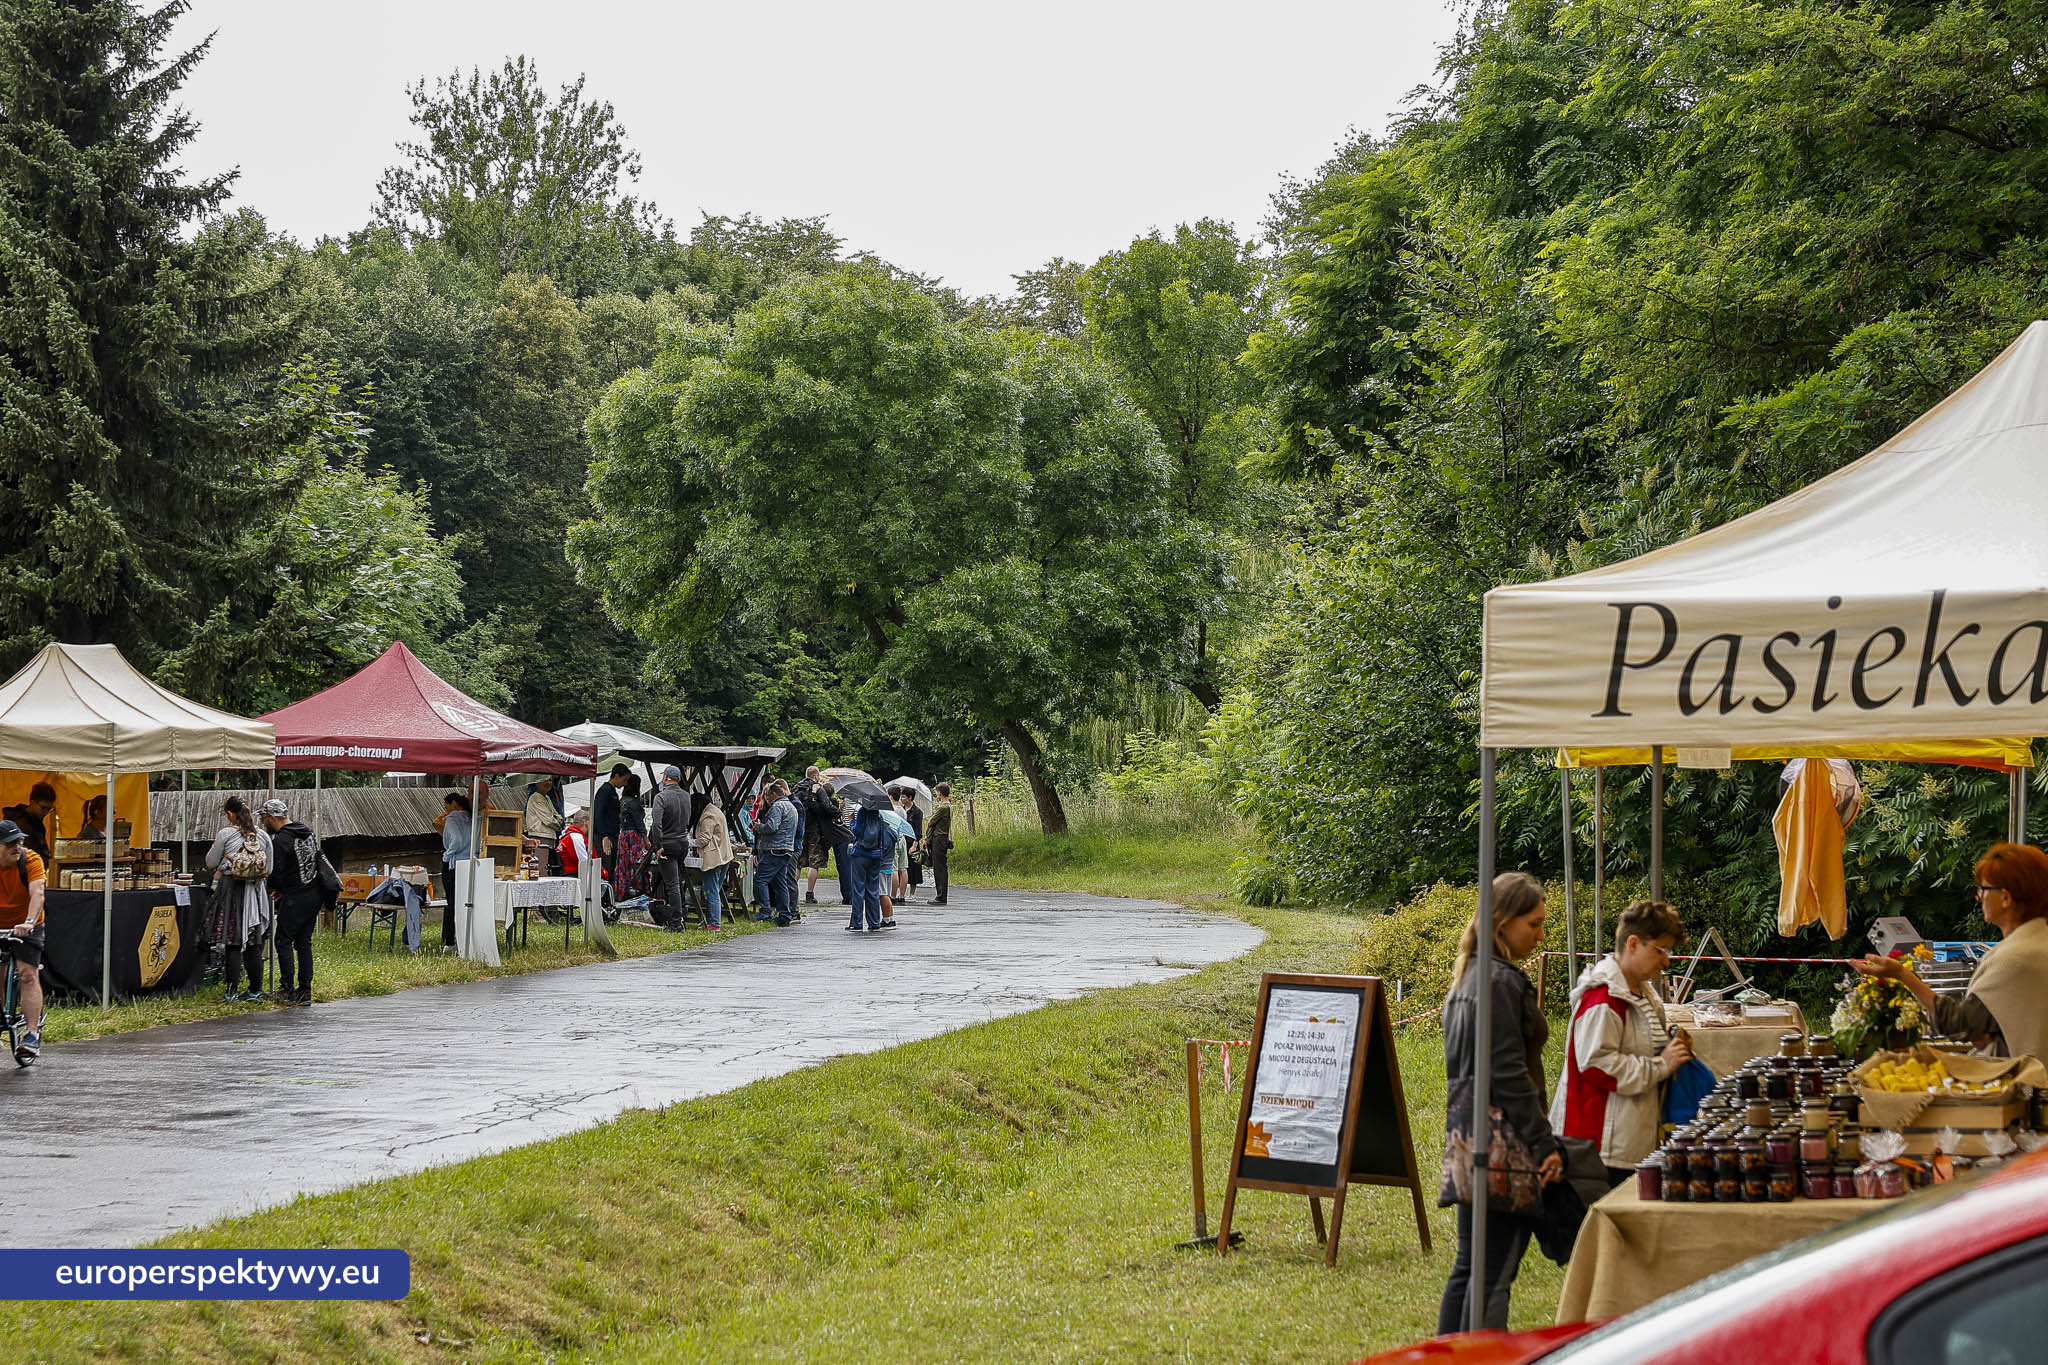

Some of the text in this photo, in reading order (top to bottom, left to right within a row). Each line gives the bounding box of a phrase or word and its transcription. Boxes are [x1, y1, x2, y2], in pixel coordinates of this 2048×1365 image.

[1591, 588, 2048, 717] Pasieka
[154, 909, 173, 918] PASIEKA
[1307, 1031, 1326, 1040] 14:30
[1274, 1042, 1294, 1050] POKAZ
[1268, 1054, 1337, 1067] MIODU Z DEGUSTACJĄ
[1285, 1097, 1315, 1109] MIODU
